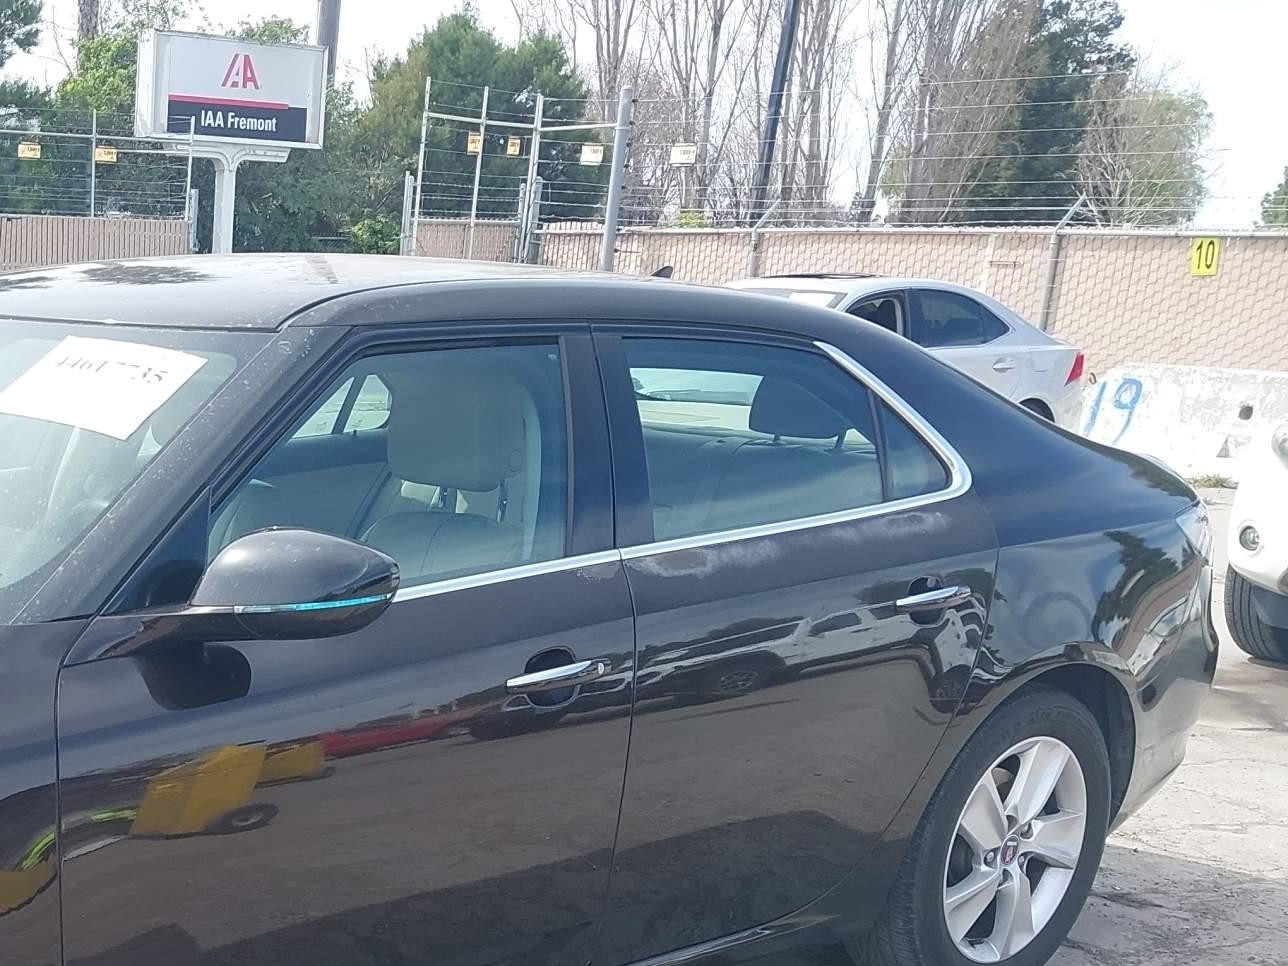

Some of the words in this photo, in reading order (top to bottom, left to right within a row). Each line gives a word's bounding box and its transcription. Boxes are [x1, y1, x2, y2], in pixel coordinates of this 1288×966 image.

[200, 109, 224, 129] IAA
[228, 111, 277, 132] Fremont
[1195, 239, 1215, 270] 10
[1084, 378, 1143, 446] 19
